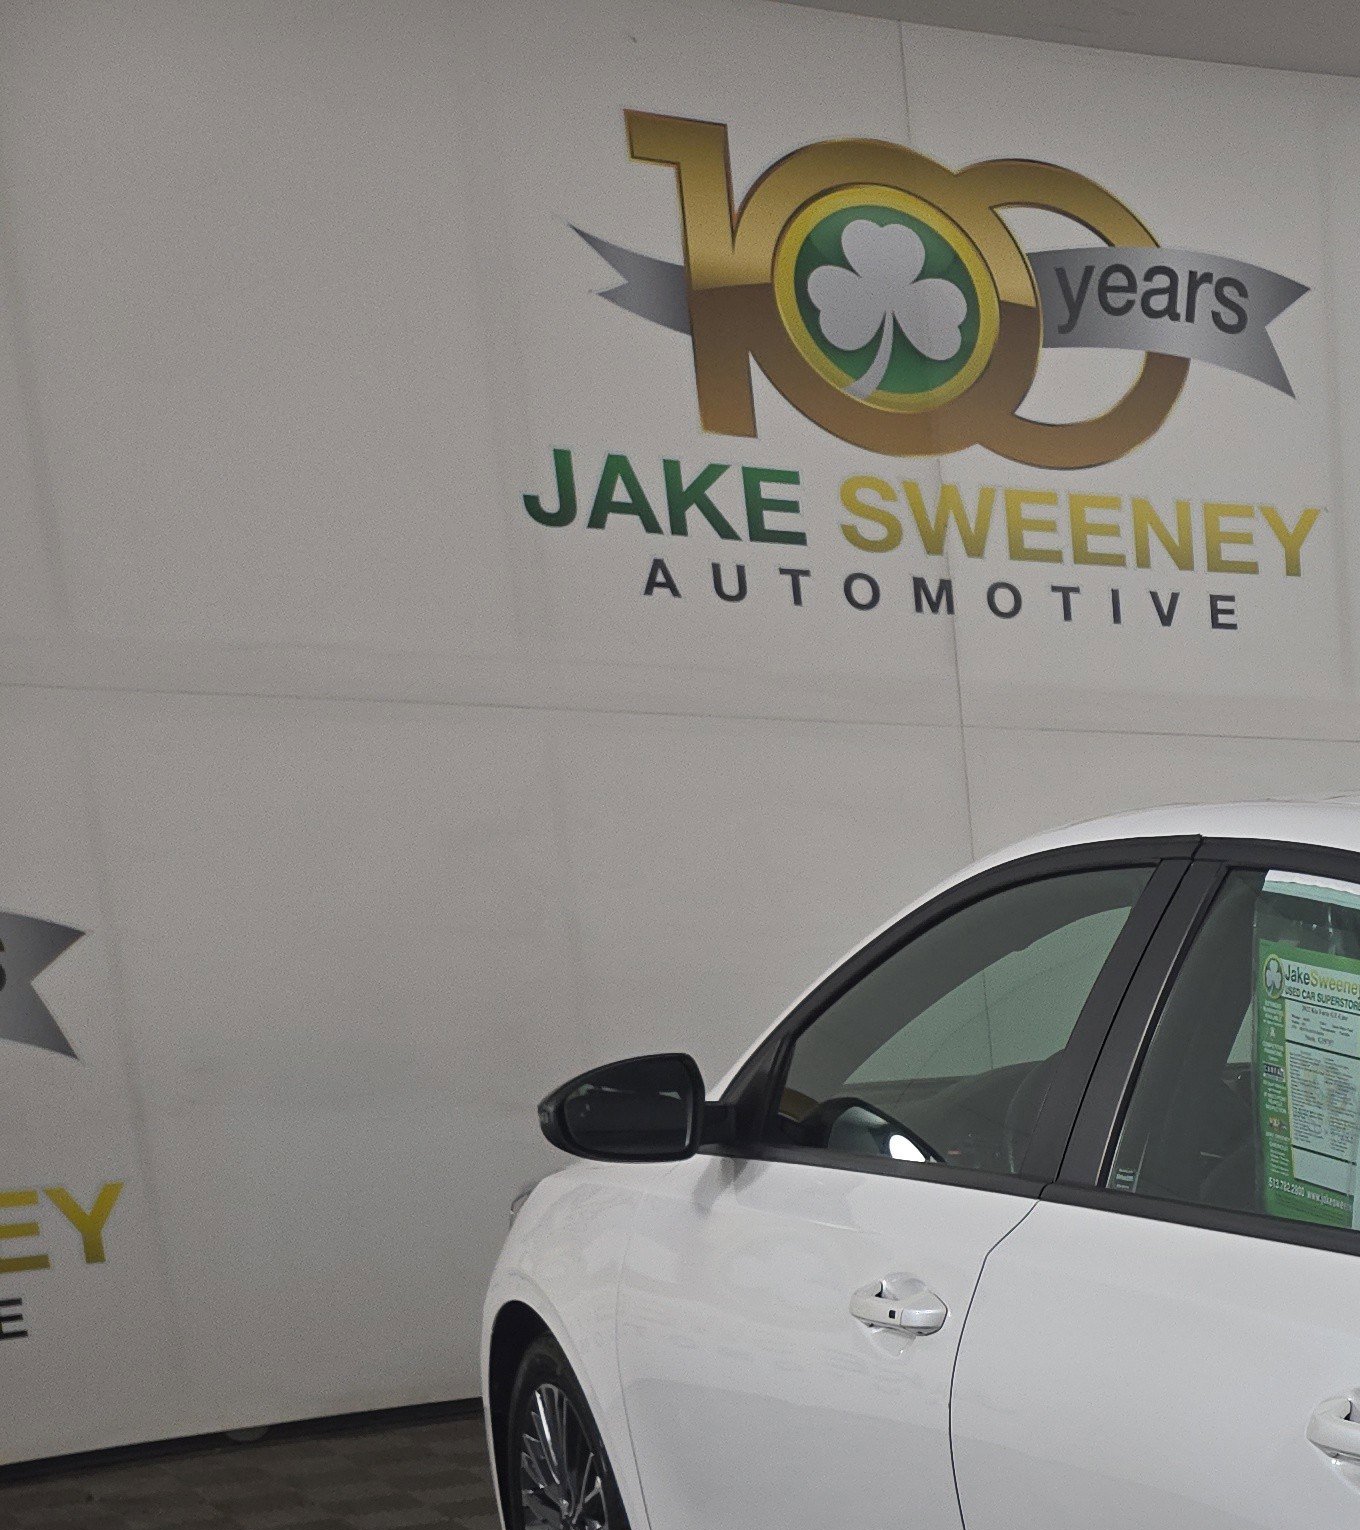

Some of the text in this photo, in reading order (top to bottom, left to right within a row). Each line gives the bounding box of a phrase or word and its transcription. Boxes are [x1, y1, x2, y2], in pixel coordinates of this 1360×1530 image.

[1055, 262, 1250, 336] years
[522, 447, 1322, 578] JAKE SWEENEY
[642, 557, 1239, 631] AUTOMOTIVE
[1301, 989, 1316, 1001] CAR
